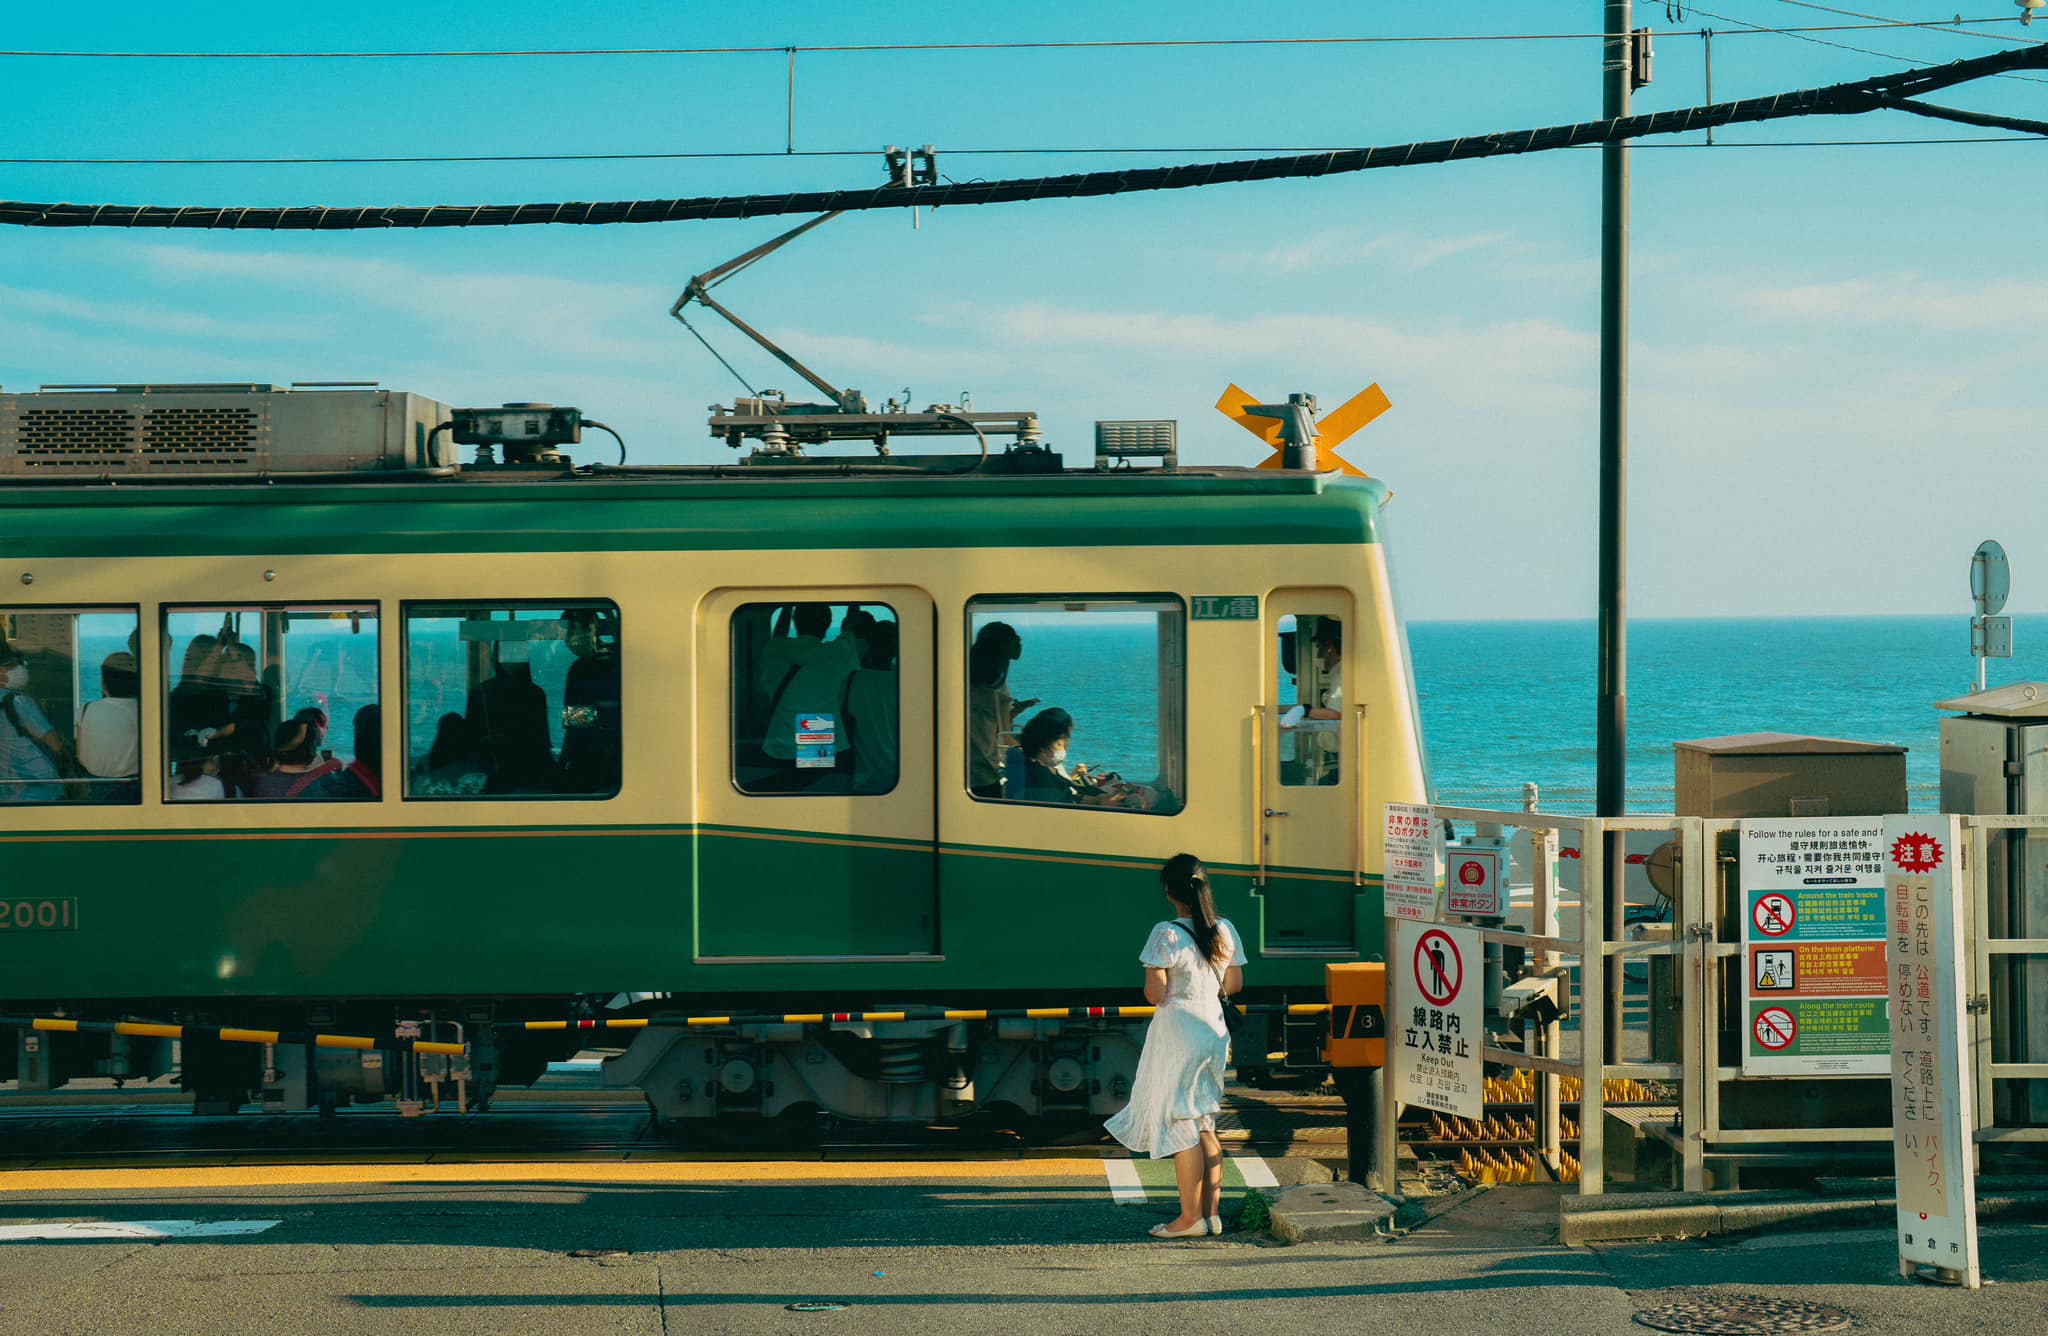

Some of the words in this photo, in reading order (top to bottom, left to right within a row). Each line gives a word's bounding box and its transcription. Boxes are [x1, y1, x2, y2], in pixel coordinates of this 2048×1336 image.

[1748, 830, 1776, 838] Follow
[1779, 829, 1792, 837] the
[1795, 829, 1816, 837] rules
[1818, 829, 1831, 837] for
[1841, 829, 1859, 837] safe
[1861, 828, 1877, 836] and
[1899, 843, 1936, 863] 注意
[1775, 864, 1802, 875] 규칙을
[1805, 864, 1822, 874] 지켜
[1450, 898, 1493, 910] 非常ボタン
[0, 900, 69, 928] 2001
[1843, 945, 1875, 953] platform
[1800, 1002, 1820, 1010] Along
[1364, 1015, 1372, 1028] 3
[1413, 1006, 1460, 1034] 線路内
[1405, 1027, 1469, 1058] 立入禁止
[1421, 1053, 1439, 1066] Keep
[1440, 1057, 1454, 1068] Out
[1409, 1072, 1423, 1084] 선로
[1426, 1076, 1433, 1087] 내
[1437, 1078, 1451, 1091] 진입
[1453, 1082, 1467, 1094] 금지
